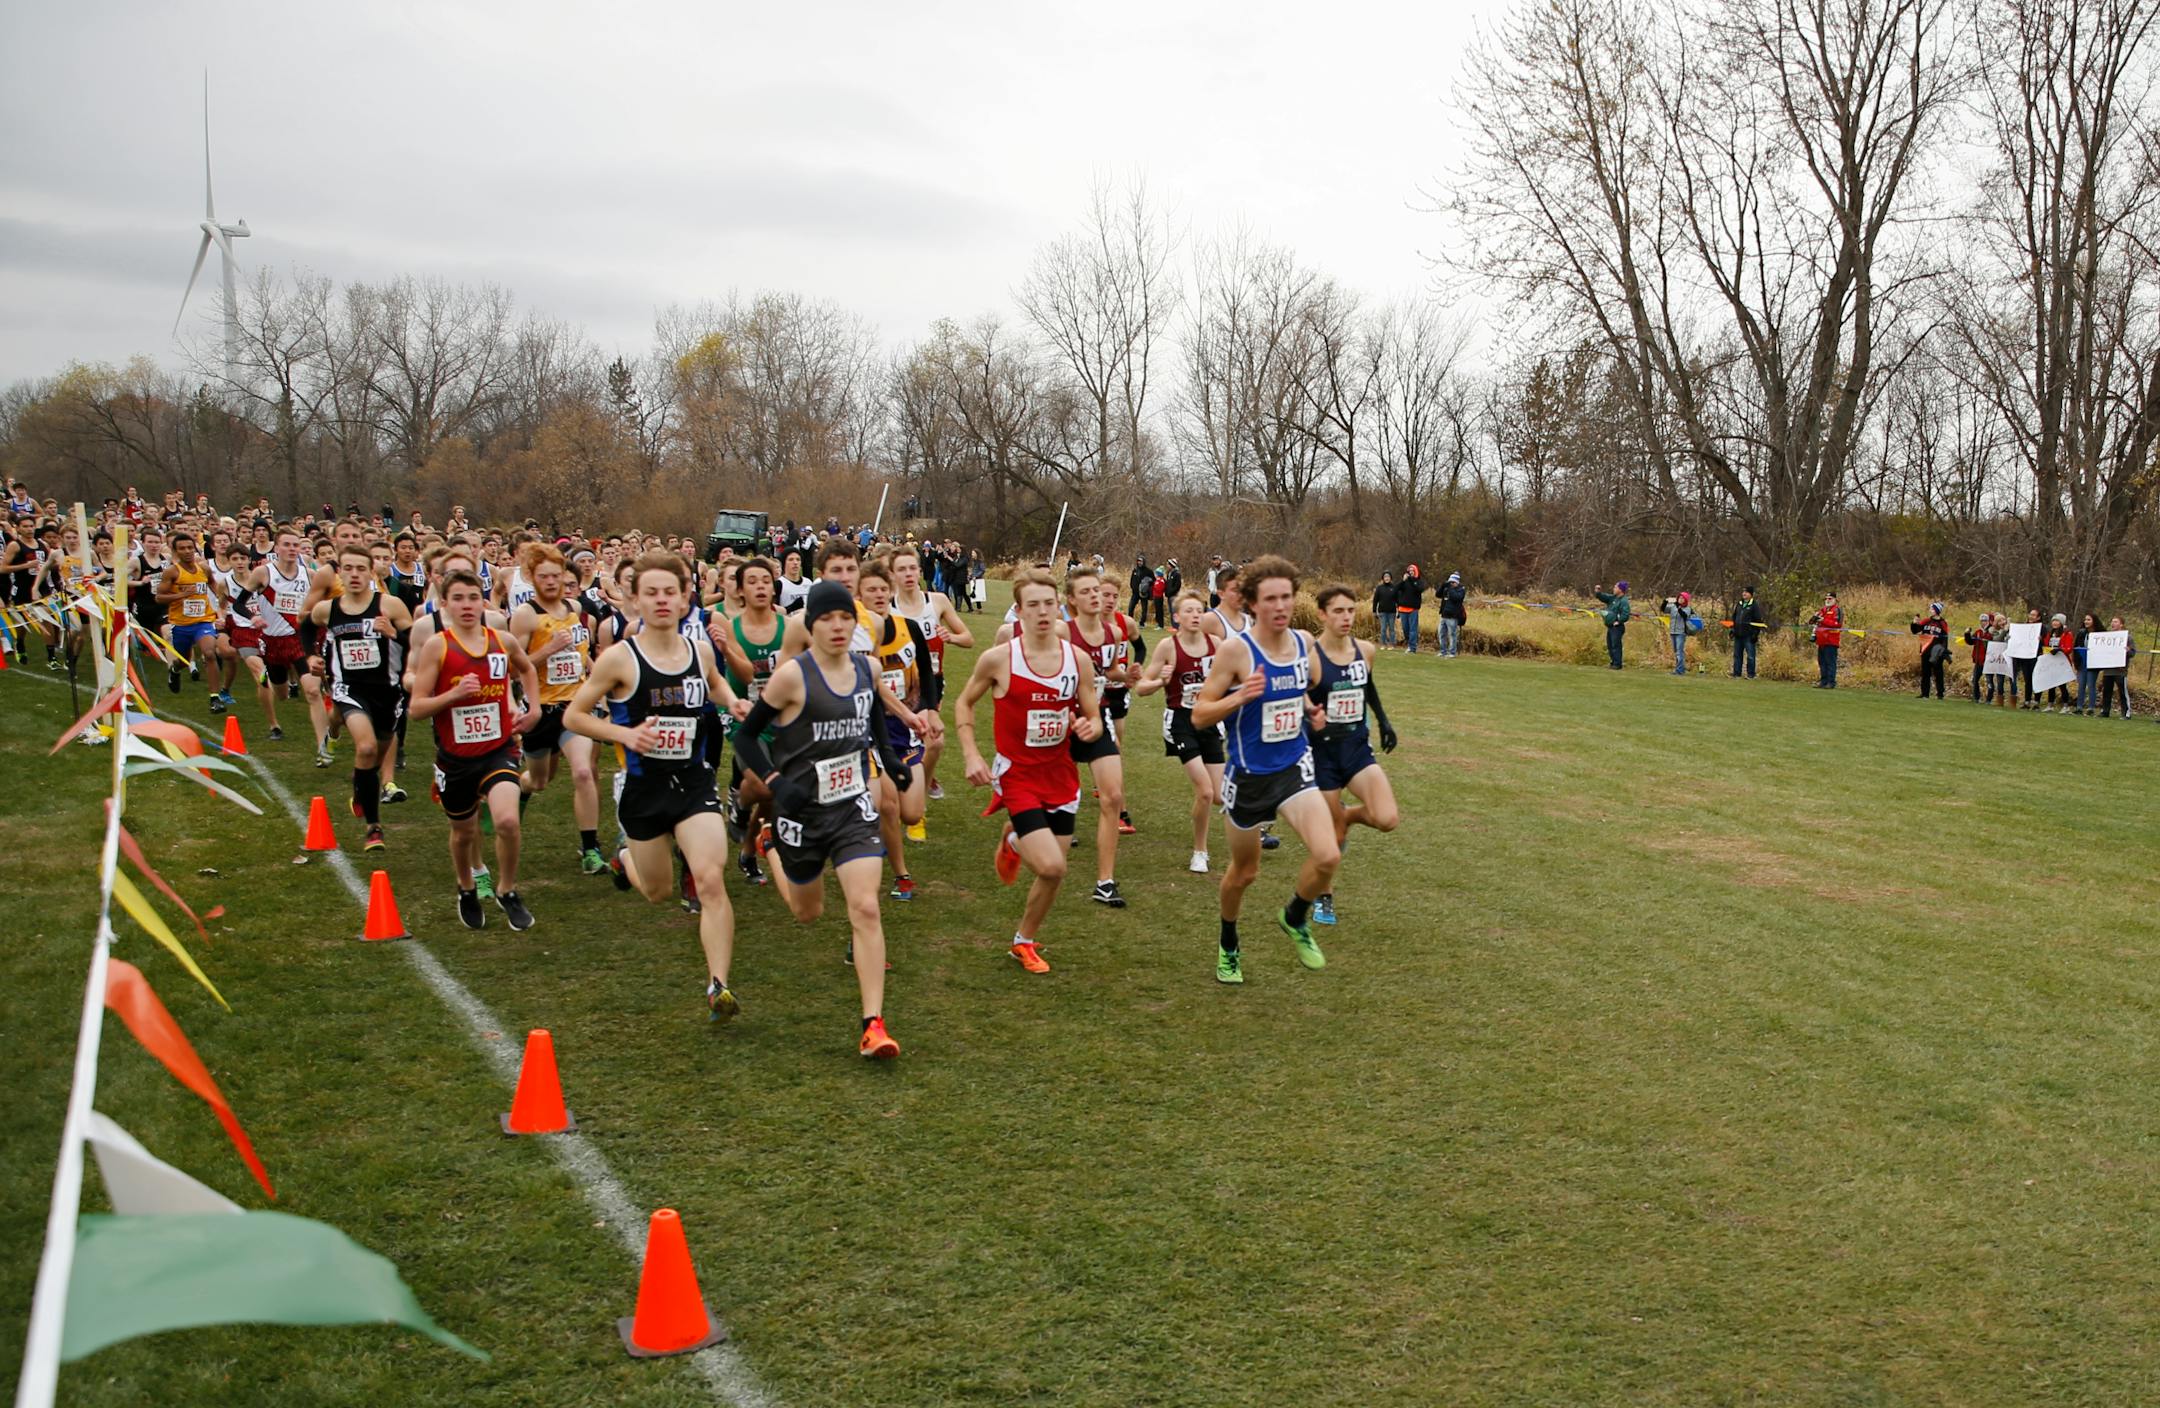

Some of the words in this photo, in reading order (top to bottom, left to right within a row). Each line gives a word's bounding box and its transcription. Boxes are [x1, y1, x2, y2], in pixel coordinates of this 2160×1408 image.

[294, 580, 306, 593] 23
[281, 598, 296, 609] 661
[686, 624, 703, 640] 21
[924, 621, 931, 635] 9
[350, 648, 370, 662] 567
[492, 657, 506, 676] 21
[556, 662, 576, 677] 591
[1351, 663, 1365, 681] 13
[687, 681, 703, 705] 21
[1061, 675, 1077, 697] 21
[1337, 700, 1357, 715] 711
[464, 715, 491, 733] 562
[1038, 721, 1063, 737] 560
[1274, 711, 1297, 732] 671
[657, 730, 685, 749] 564
[829, 767, 853, 790] 559
[780, 822, 799, 843] 21
